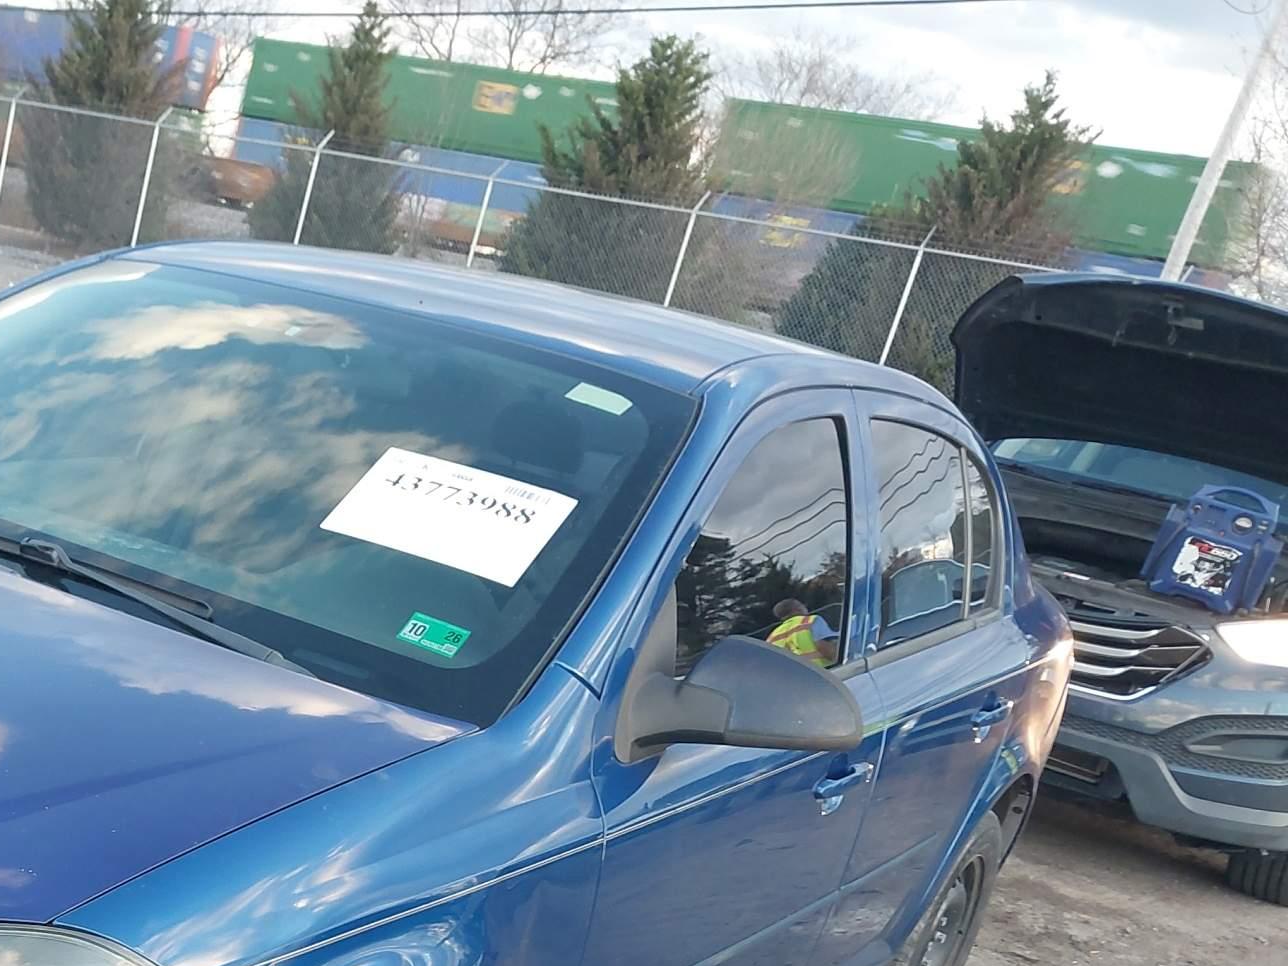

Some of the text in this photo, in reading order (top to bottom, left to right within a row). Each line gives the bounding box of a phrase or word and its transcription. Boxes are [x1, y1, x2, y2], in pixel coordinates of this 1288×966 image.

[385, 473, 535, 524] 43773988
[408, 622, 427, 637] 10
[444, 631, 463, 643] 26
